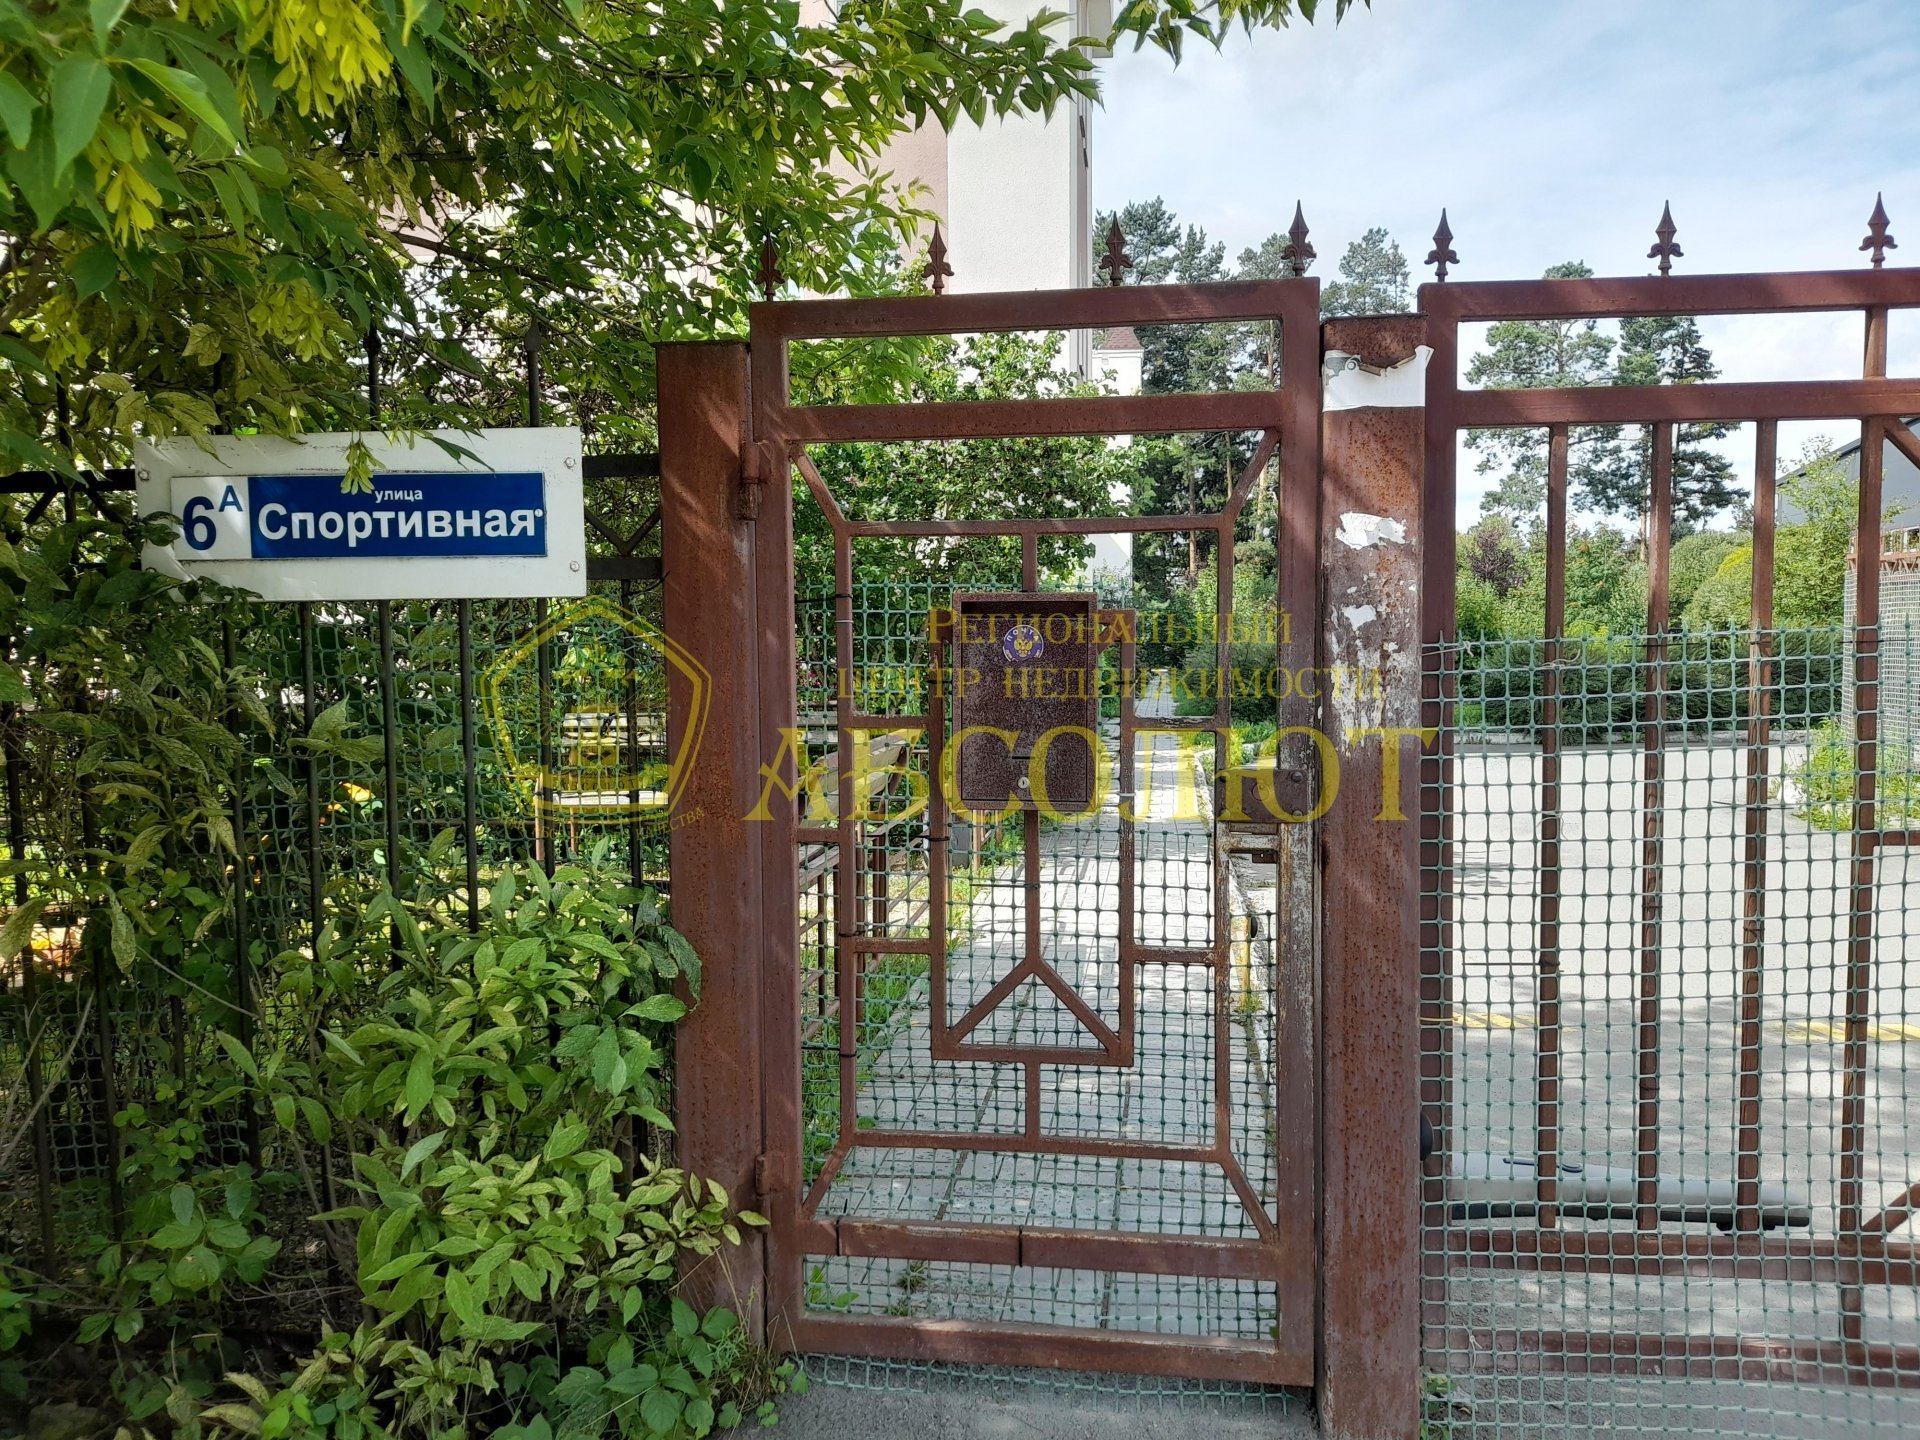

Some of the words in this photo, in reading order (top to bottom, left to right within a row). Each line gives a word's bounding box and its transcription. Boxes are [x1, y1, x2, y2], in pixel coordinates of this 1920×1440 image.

[374, 488, 423, 504] улица
[257, 503, 536, 548] Спортивная
[1006, 627, 1040, 642] ПОЧТА
